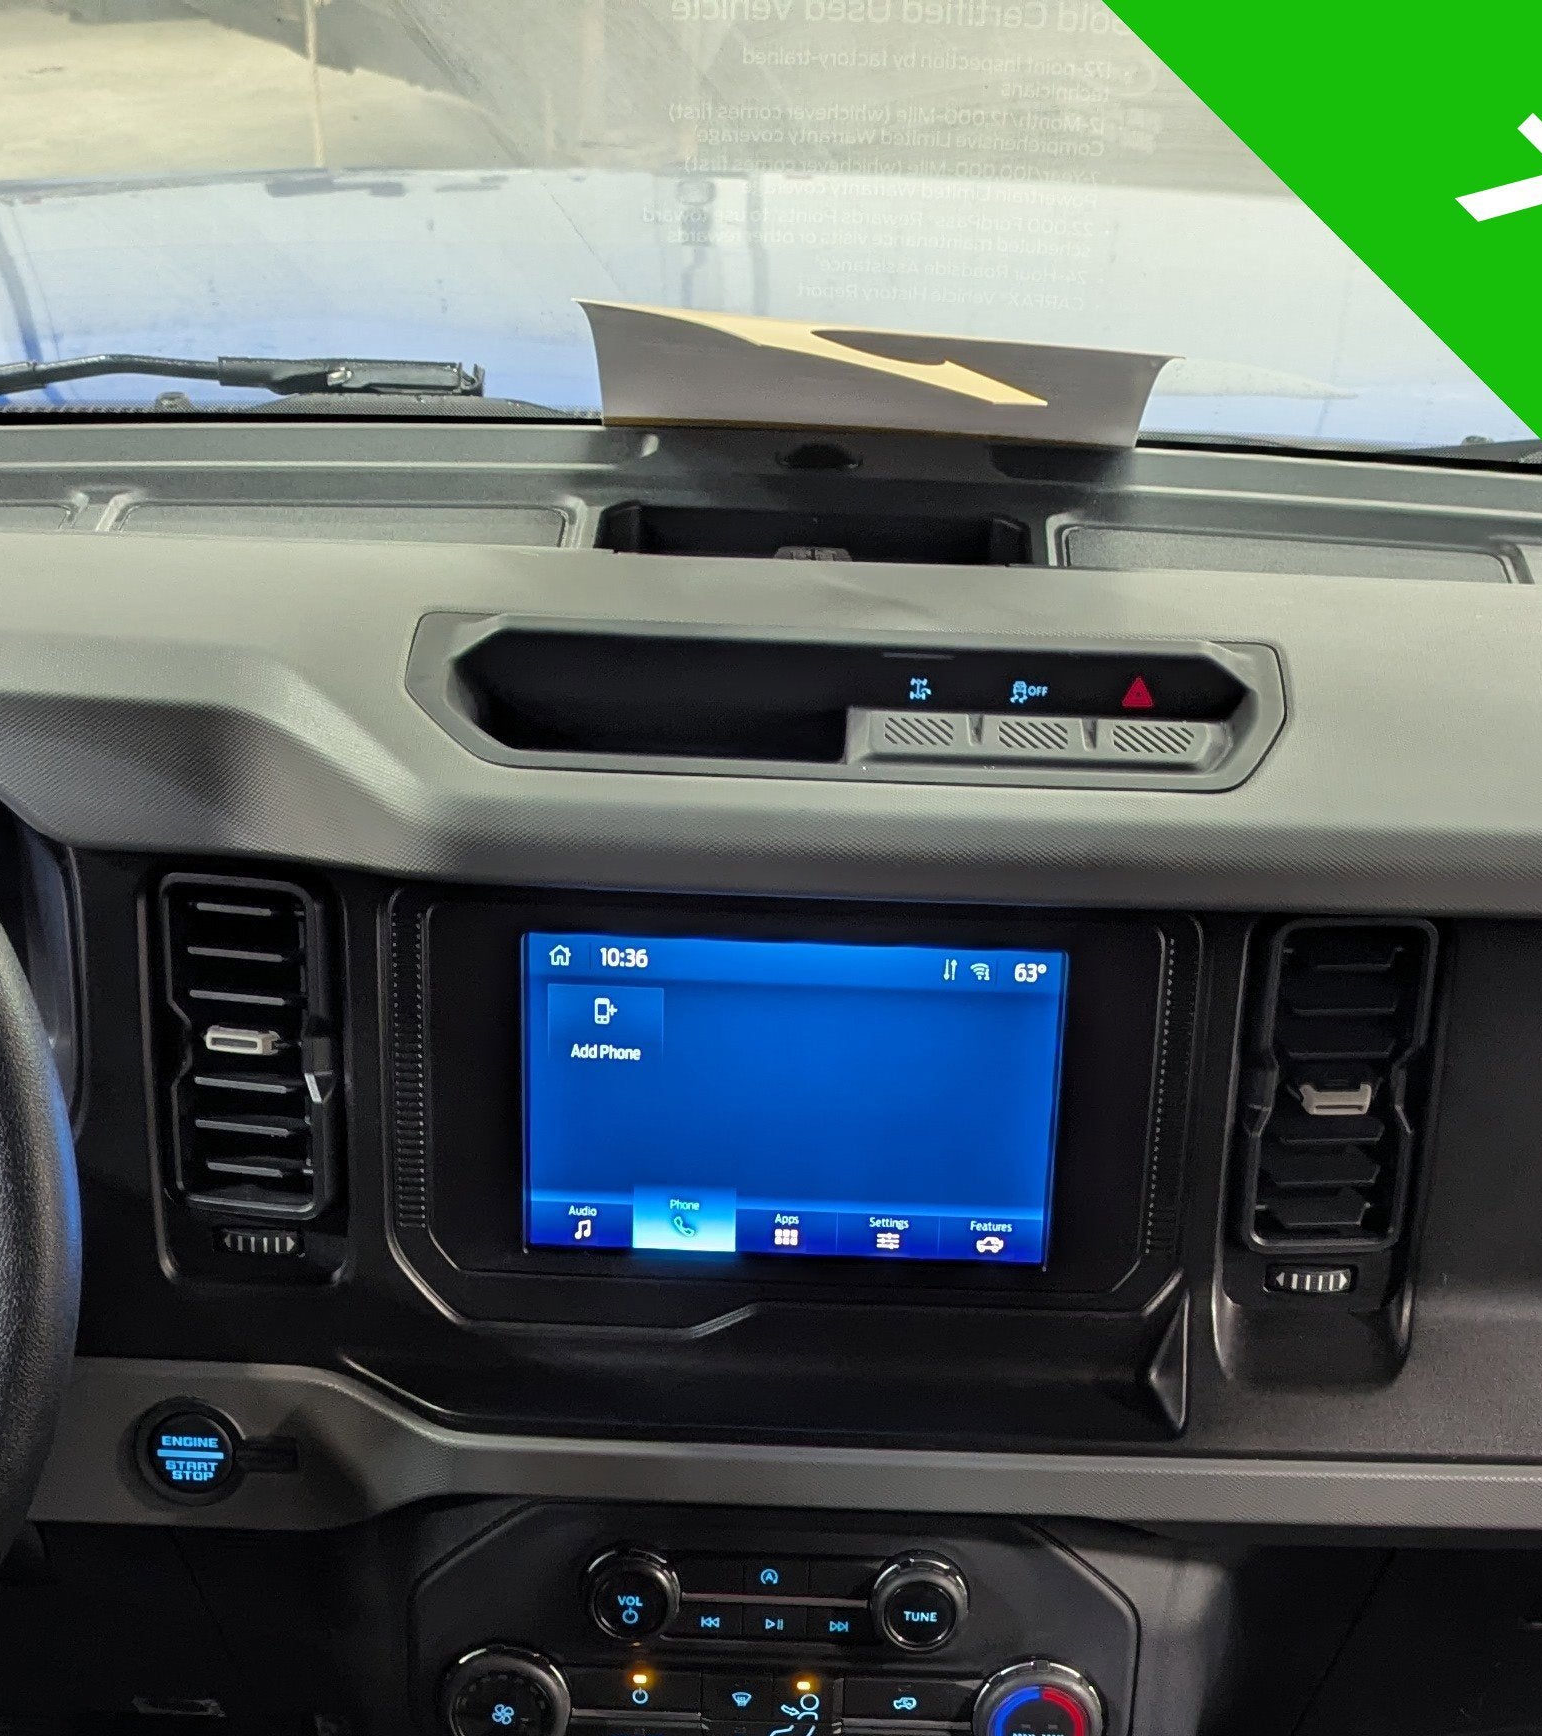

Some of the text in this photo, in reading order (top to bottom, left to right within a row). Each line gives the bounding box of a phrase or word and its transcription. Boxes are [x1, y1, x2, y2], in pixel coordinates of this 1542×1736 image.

[1027, 686, 1049, 698] OFF
[599, 947, 649, 969] 10:36
[570, 1043, 642, 1062] Add Phone
[568, 1204, 598, 1218] Audio
[669, 1198, 701, 1212] Phone
[774, 1212, 800, 1227] Apps
[868, 1216, 910, 1232] Settings
[969, 1221, 1013, 1233] Features
[161, 1435, 220, 1449] ENGINE
[165, 1459, 219, 1473] START
[172, 1470, 215, 1482] STOP
[617, 1596, 644, 1608] VOL
[903, 1610, 939, 1623] TUNE
